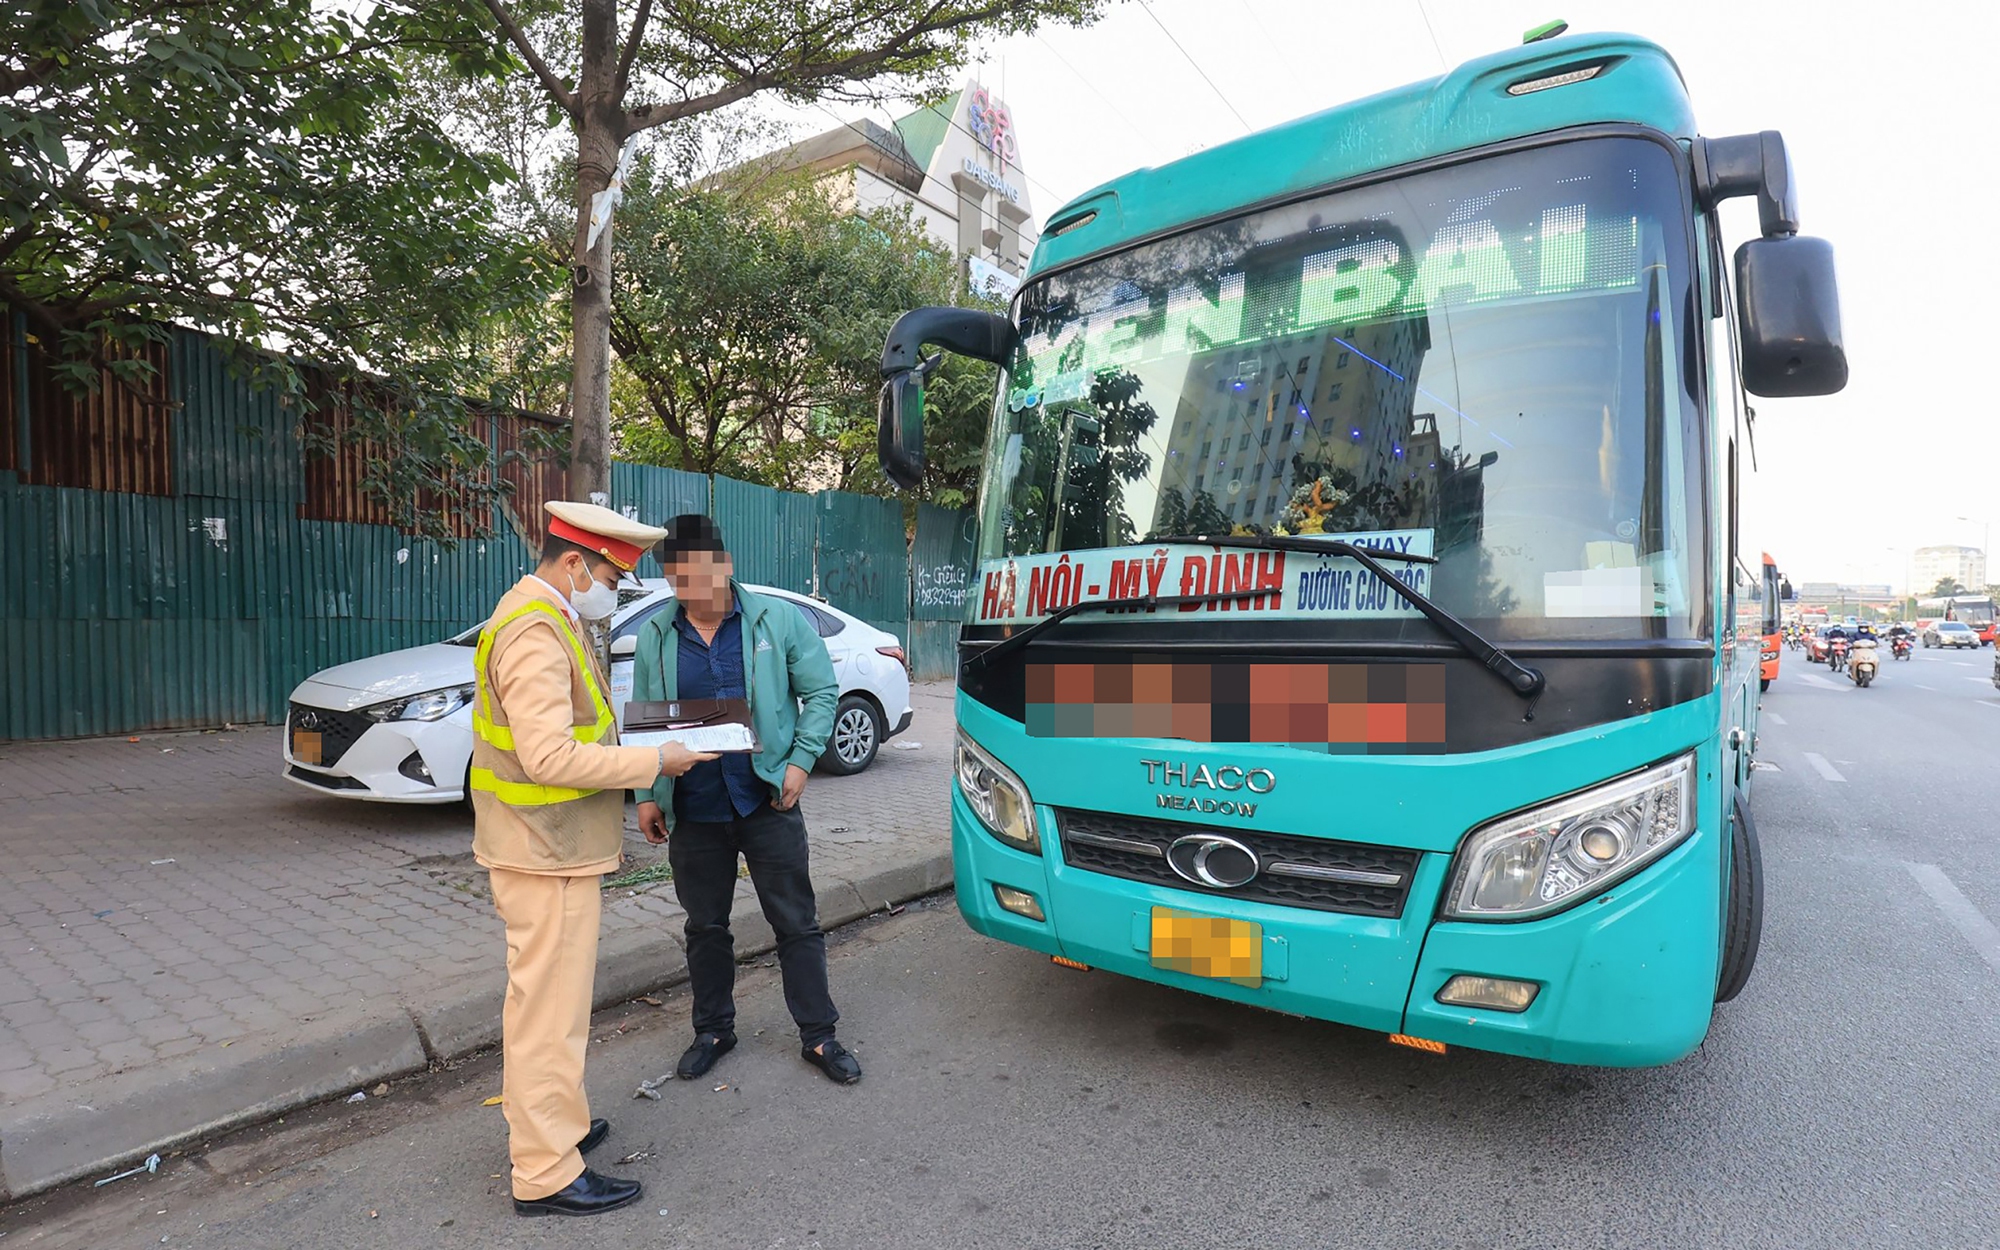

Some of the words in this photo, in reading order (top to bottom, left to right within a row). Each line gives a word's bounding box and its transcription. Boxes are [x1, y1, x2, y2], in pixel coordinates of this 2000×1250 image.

[964, 157, 1019, 203] DAESANG
[981, 560, 1017, 620] HÀ
[1107, 548, 1169, 613] MỸ
[1178, 545, 1285, 612] ĐÌNH
[1297, 562, 1352, 611] ĐƯỜNG
[1356, 569, 1388, 611] CAO
[1140, 758, 1276, 794] THACO
[1156, 793, 1257, 818] MEADOW
